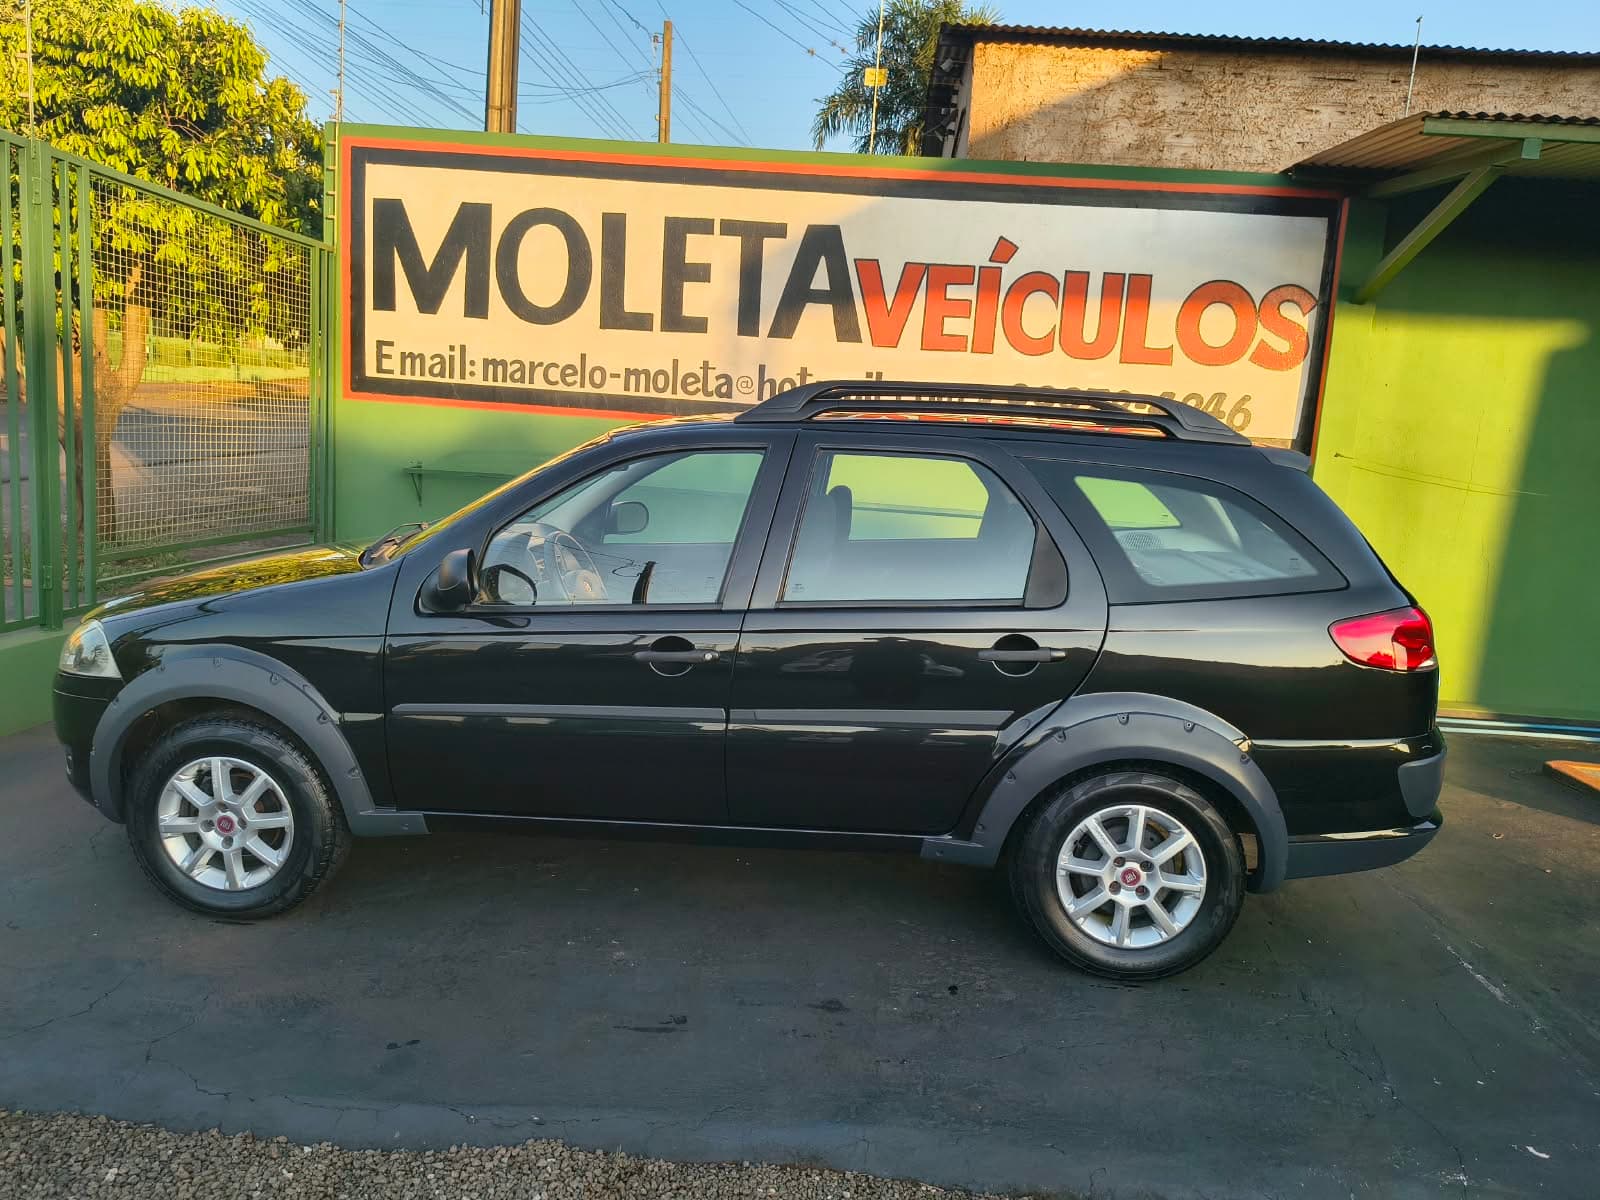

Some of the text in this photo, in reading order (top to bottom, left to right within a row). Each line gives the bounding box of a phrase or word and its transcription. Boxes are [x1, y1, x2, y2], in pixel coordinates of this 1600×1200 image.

[373, 198, 1317, 371] MOLETA VEÍCULOS
[376, 341, 476, 378] Email:
